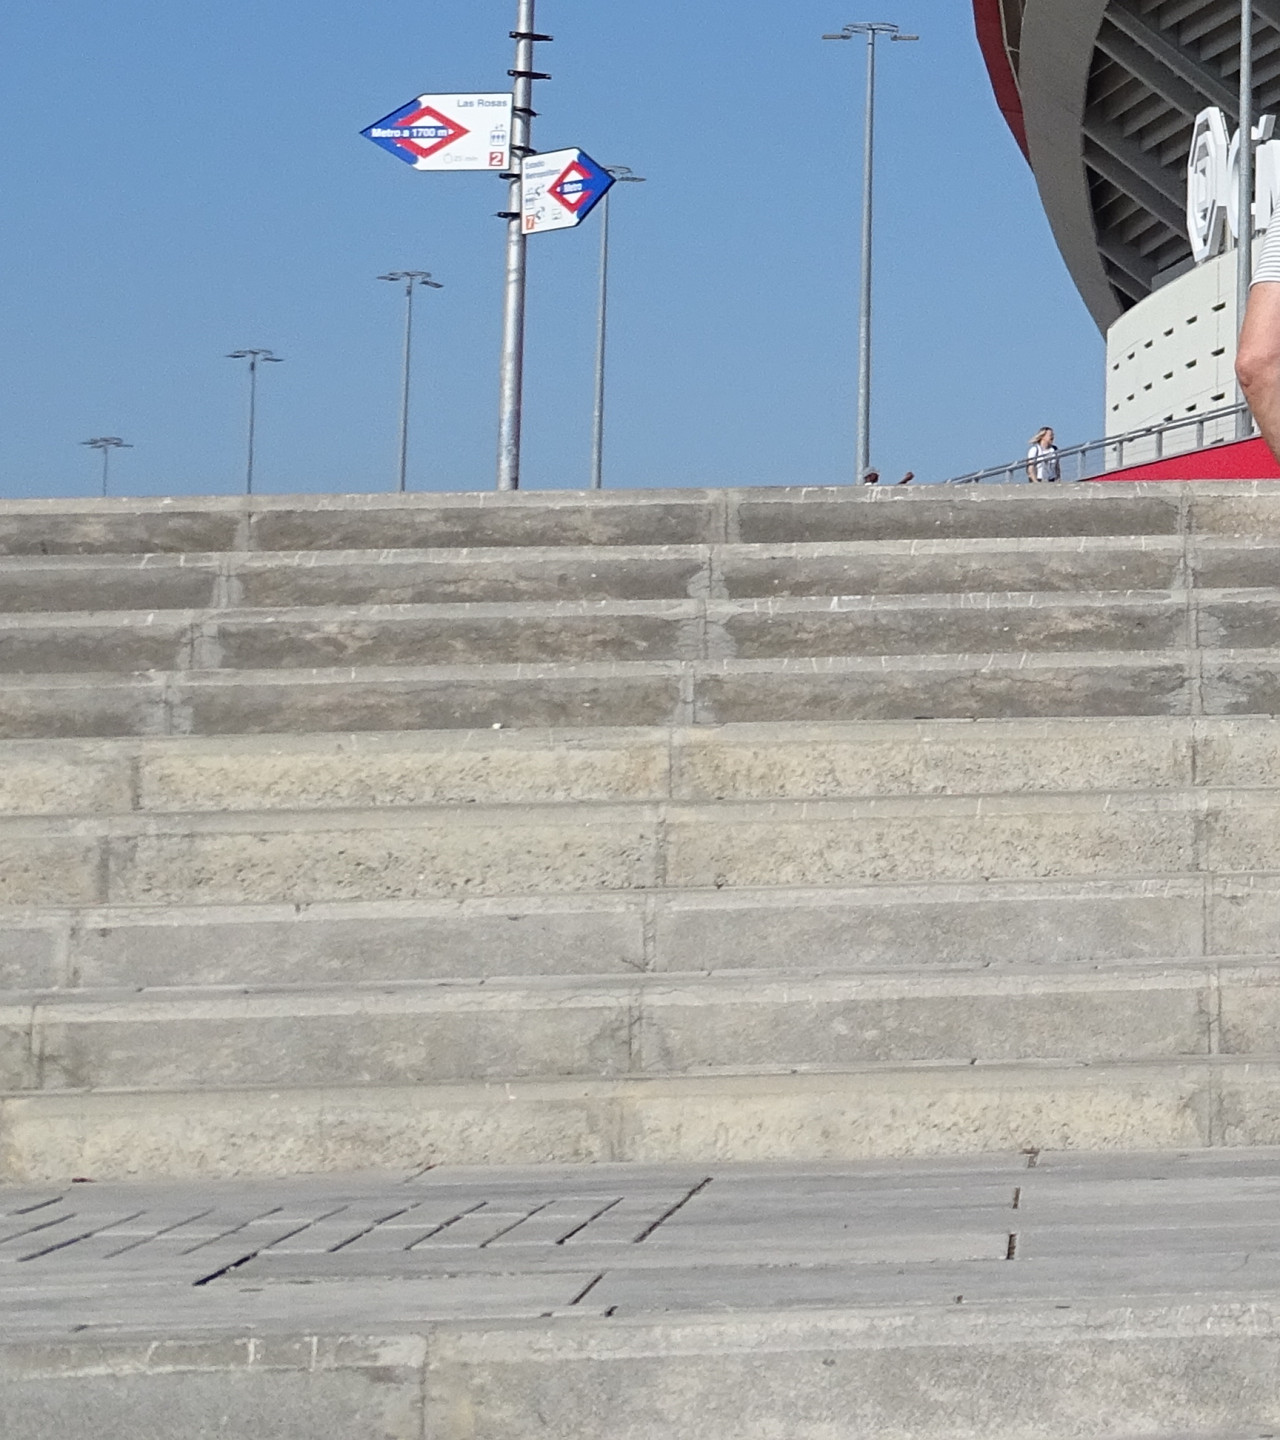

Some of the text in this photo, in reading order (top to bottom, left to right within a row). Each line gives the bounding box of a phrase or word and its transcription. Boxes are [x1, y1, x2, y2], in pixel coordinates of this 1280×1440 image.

[457, 98, 508, 108] Las Rosas
[371, 127, 448, 137] Metro a 1700 m
[491, 153, 502, 165] 2
[526, 215, 534, 230] 7
